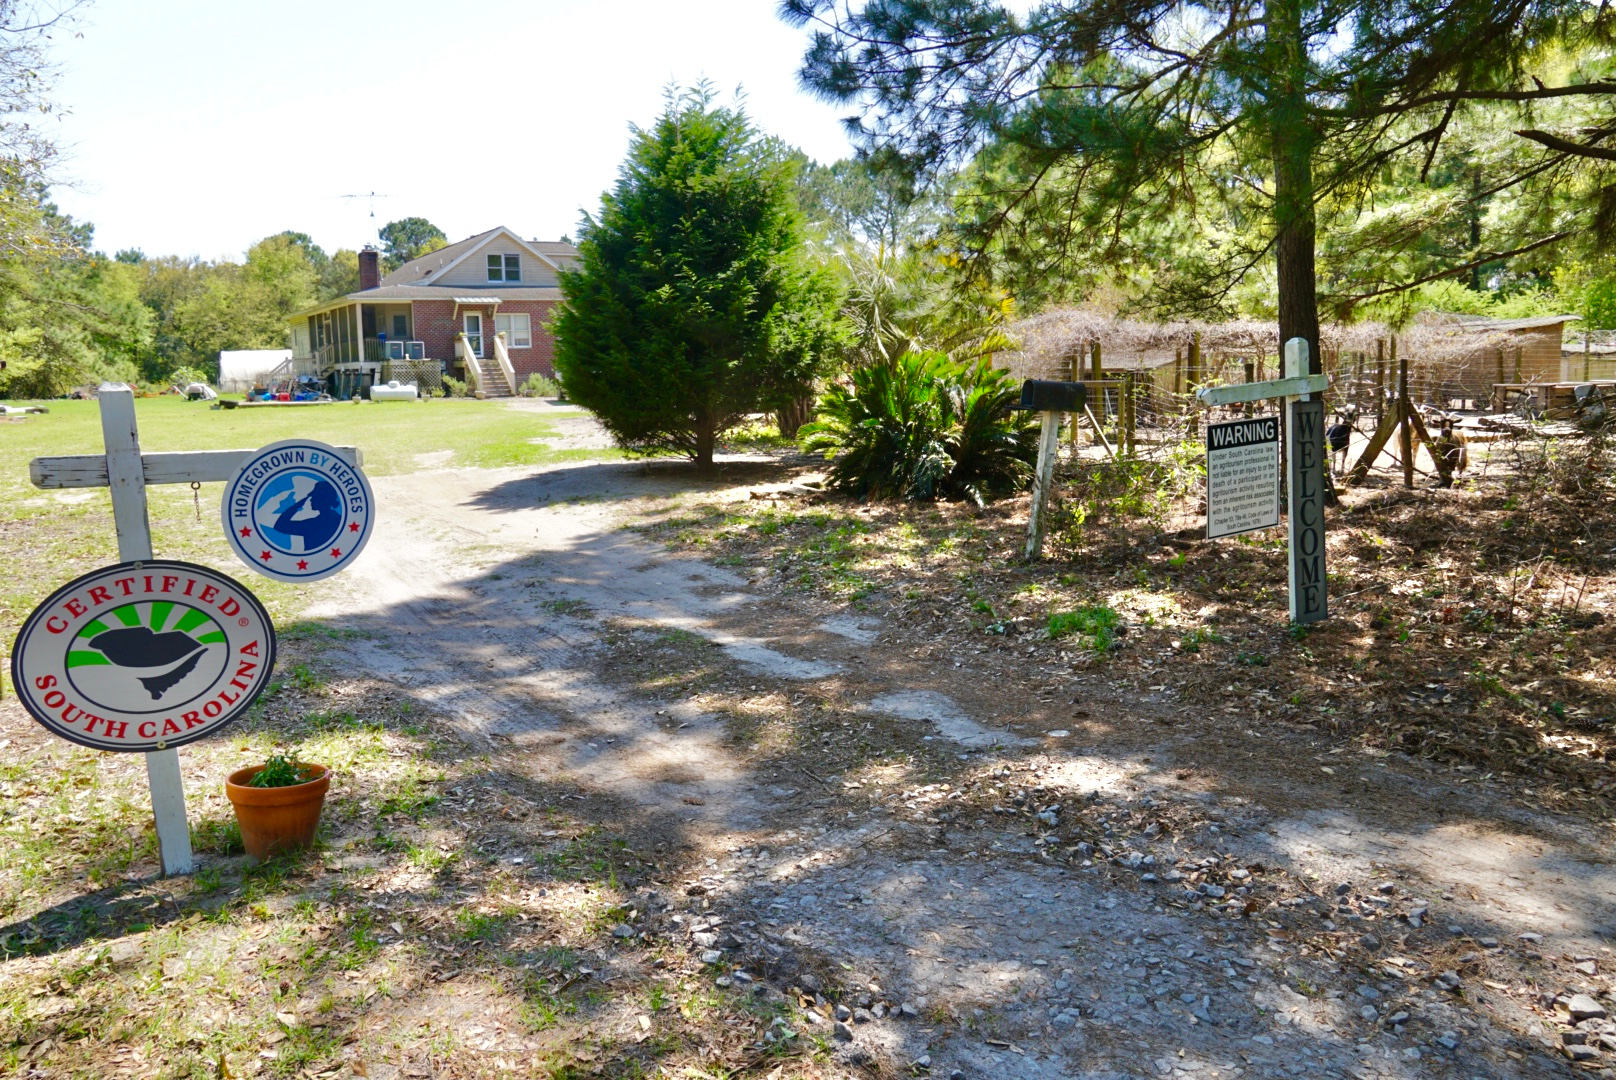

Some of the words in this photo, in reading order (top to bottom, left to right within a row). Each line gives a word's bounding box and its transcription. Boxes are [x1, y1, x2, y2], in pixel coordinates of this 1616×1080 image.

[1212, 421, 1275, 447] WARNING
[1220, 460, 1243, 470] agritourism
[1245, 456, 1269, 465] professional
[235, 451, 304, 517] HOMEGROWN
[310, 452, 330, 467] BY
[329, 462, 363, 513] HEROES
[1238, 474, 1261, 484] participant
[1213, 488, 1237, 498] agritourism
[1254, 490, 1274, 498] associated
[1232, 502, 1256, 512] agritourism
[1296, 412, 1321, 615] WELCOME
[46, 576, 240, 634] CERTIFIED
[36, 674, 129, 738] SOUTH
[138, 640, 258, 738] CAROLINA
